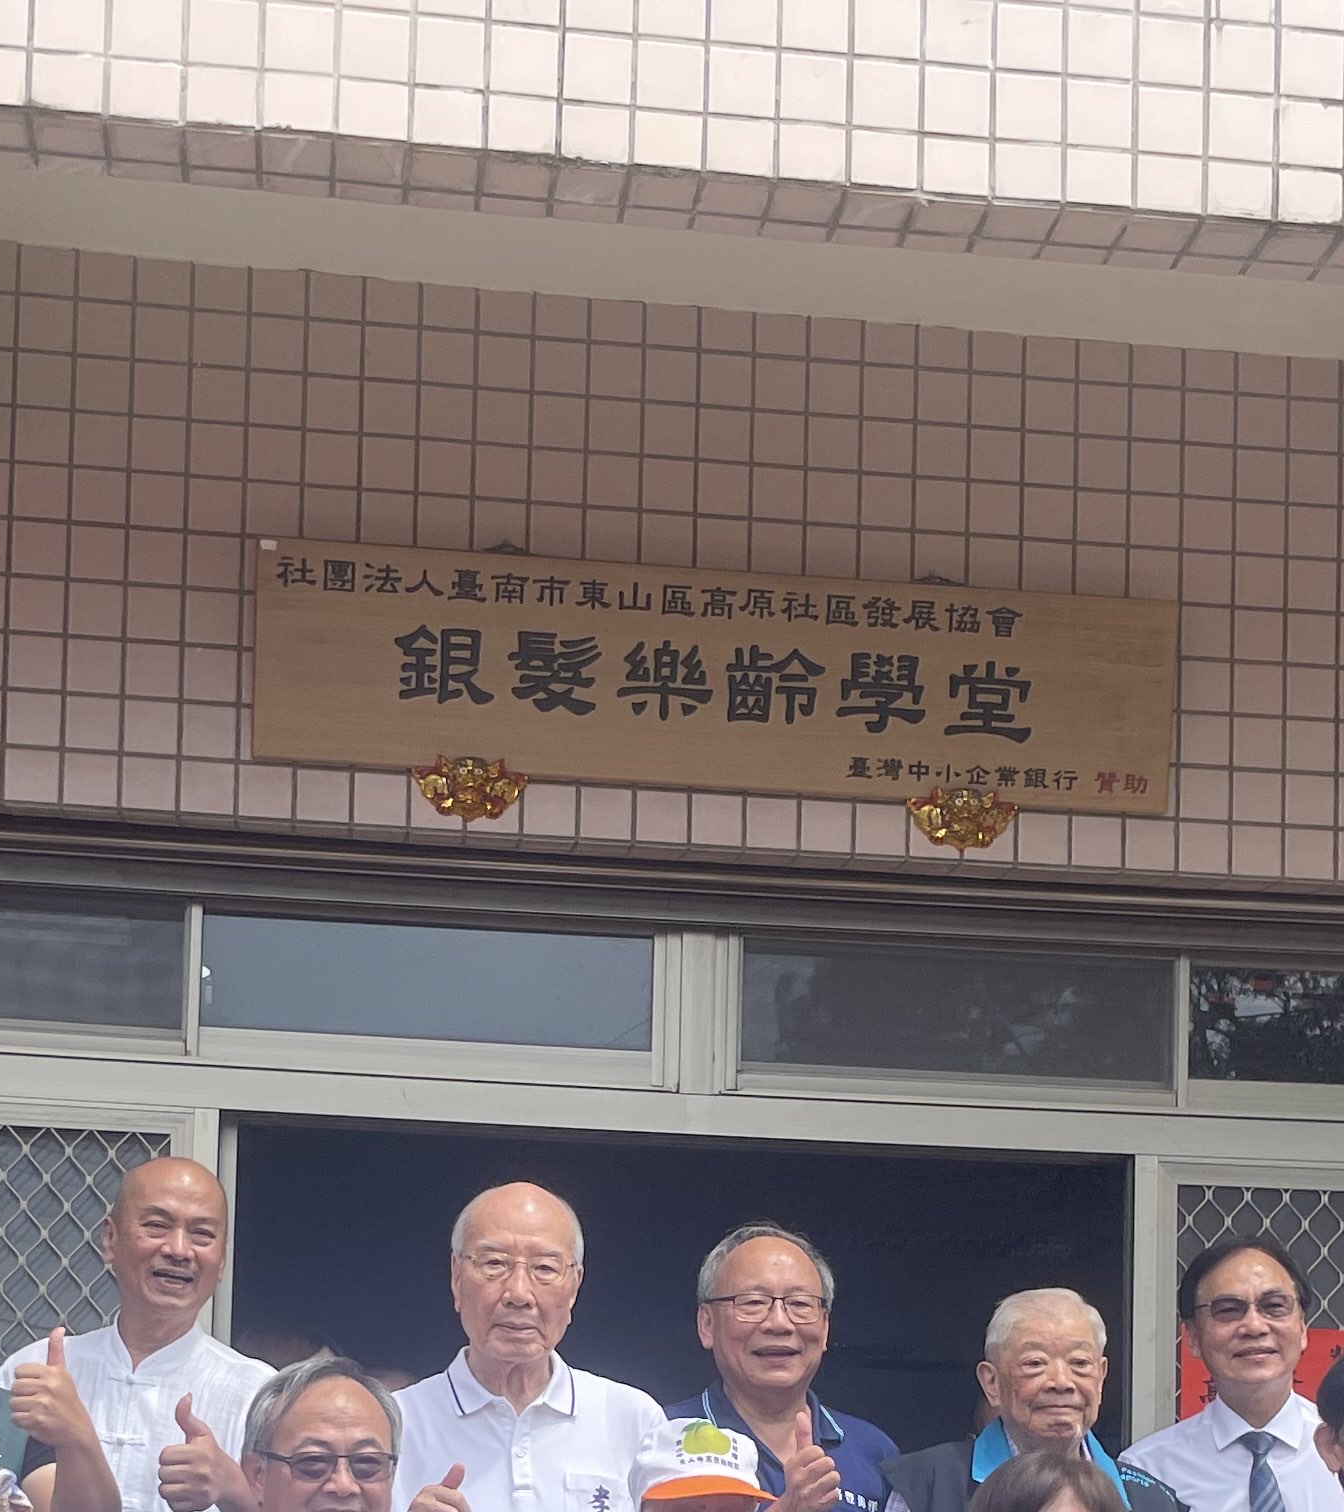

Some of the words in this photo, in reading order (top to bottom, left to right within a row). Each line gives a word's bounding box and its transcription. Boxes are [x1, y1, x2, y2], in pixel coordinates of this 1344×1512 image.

[276, 554, 1023, 638] 社團法人臺南市東山區高原社區發展協會
[394, 623, 1033, 743] 銀髮樂齡學堂
[845, 756, 1079, 793] 臺灣中小企業銀行
[1095, 770, 1149, 796] 贊助
